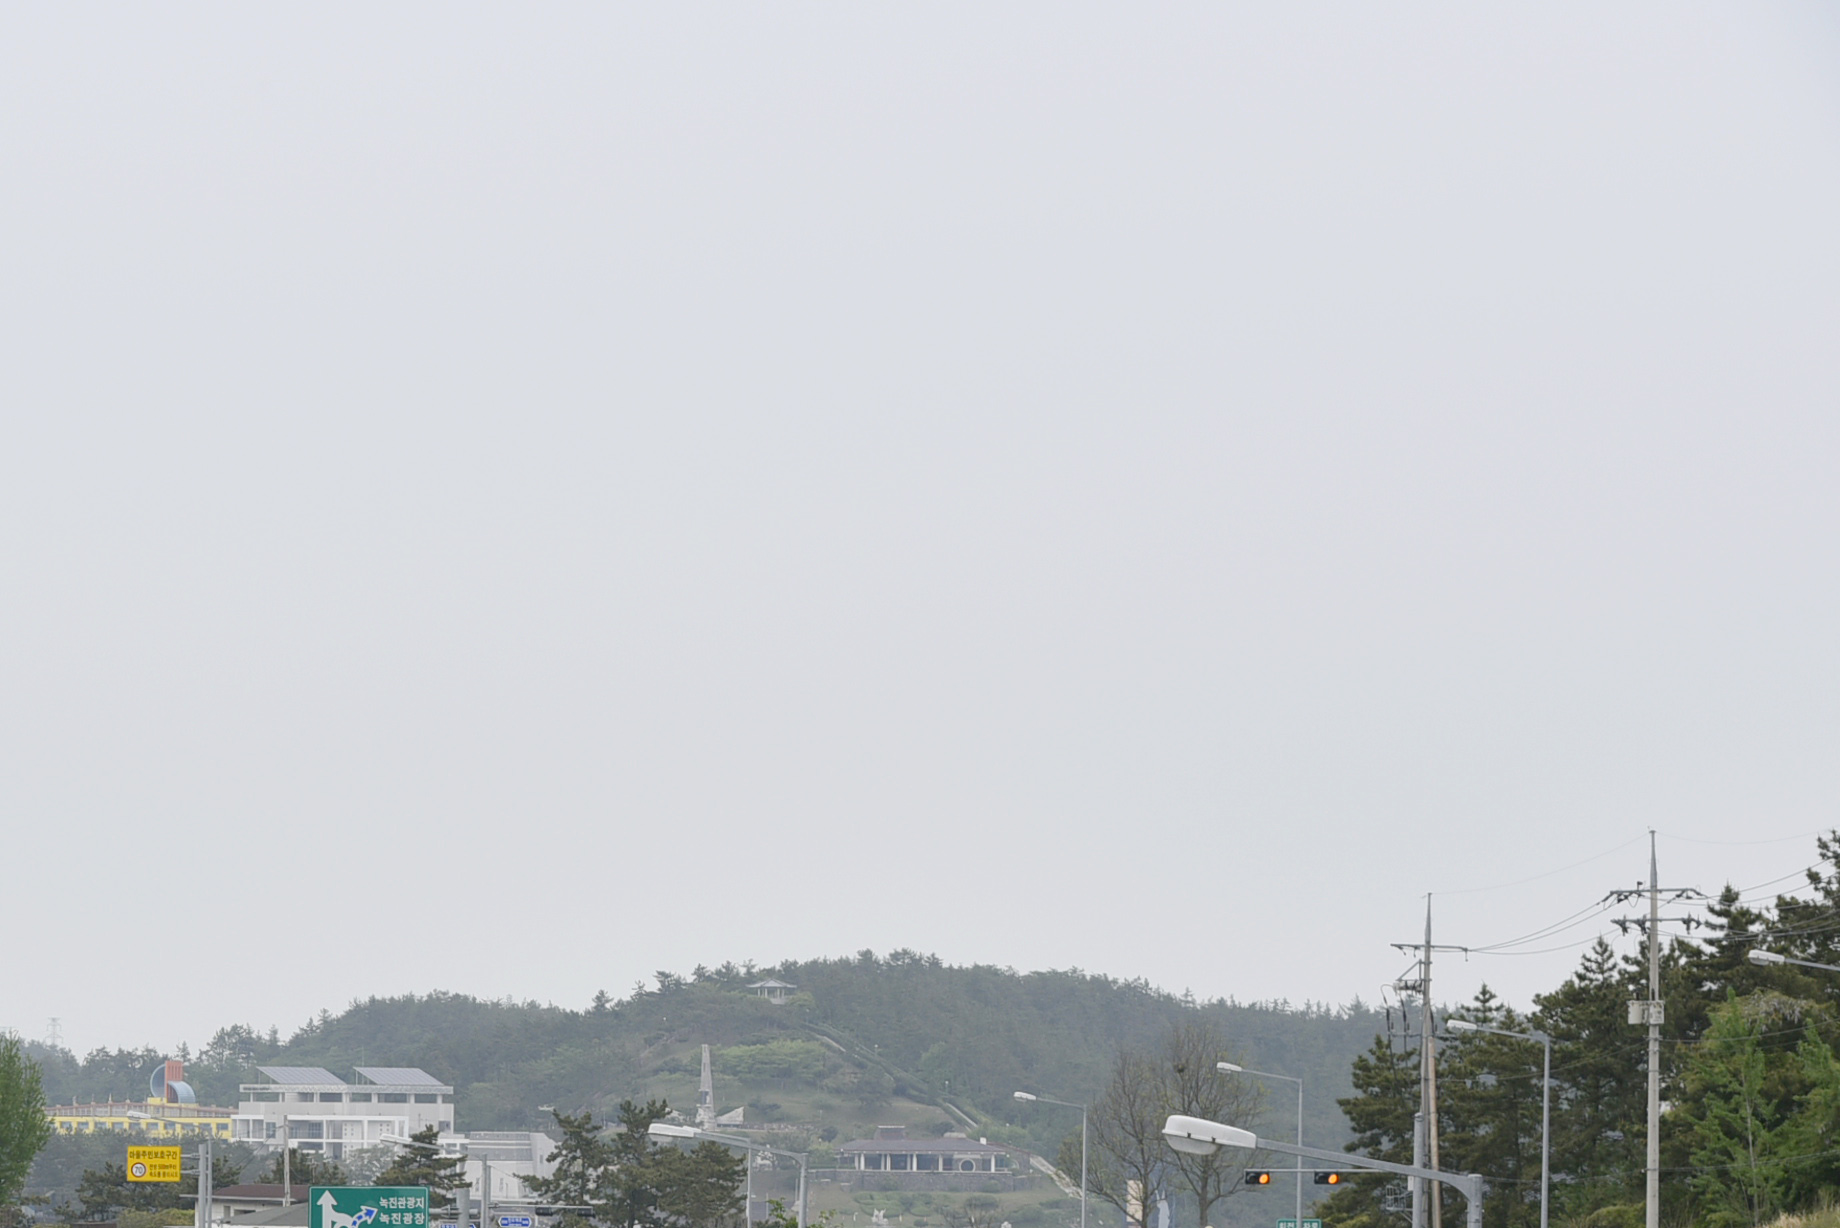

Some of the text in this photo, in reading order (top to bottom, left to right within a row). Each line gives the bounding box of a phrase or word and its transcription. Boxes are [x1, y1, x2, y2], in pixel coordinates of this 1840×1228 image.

[134, 1166, 144, 1174] 70
[379, 1196, 425, 1209] 녹진관광지
[379, 1212, 425, 1225] 녹진광장
